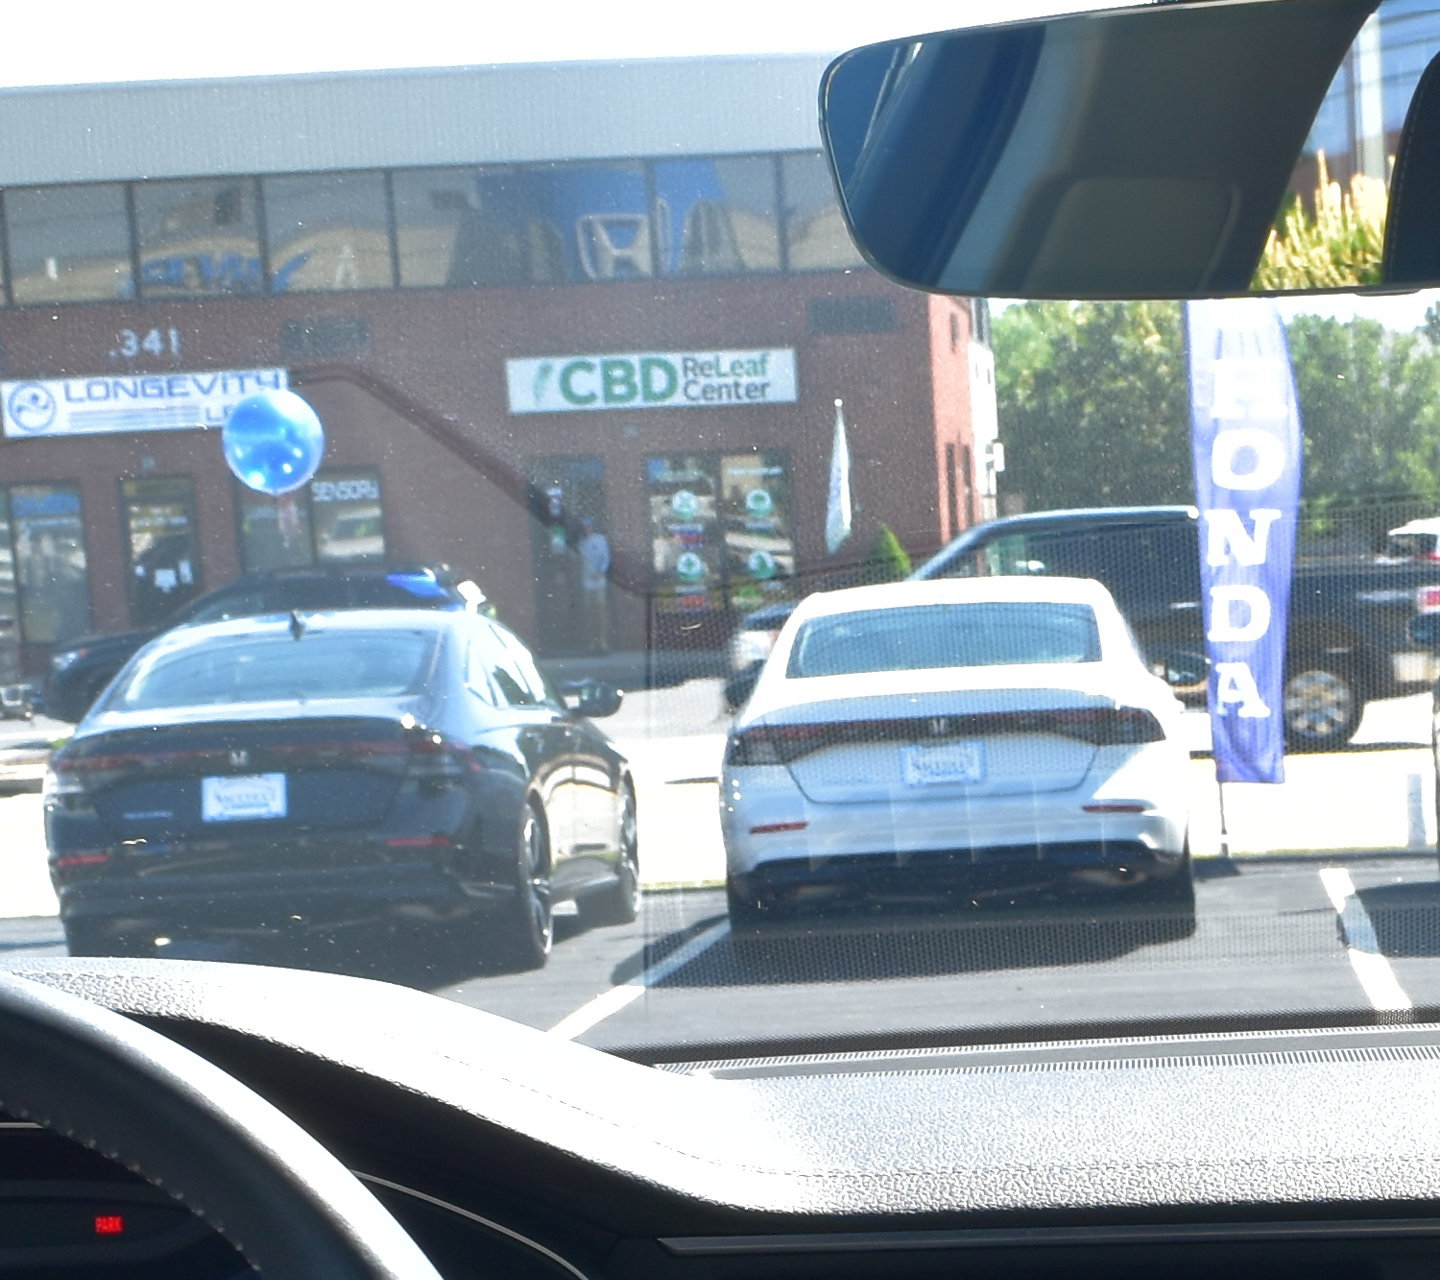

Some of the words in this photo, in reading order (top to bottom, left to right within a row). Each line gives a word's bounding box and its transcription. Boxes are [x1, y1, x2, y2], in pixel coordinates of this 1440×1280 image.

[682, 351, 769, 378] ReLeaf
[64, 371, 281, 403] LONGEVITY
[559, 357, 679, 405] CBD
[683, 379, 771, 401] Center
[1204, 358, 1290, 719] HONDA
[95, 1216, 123, 1234] PARK
